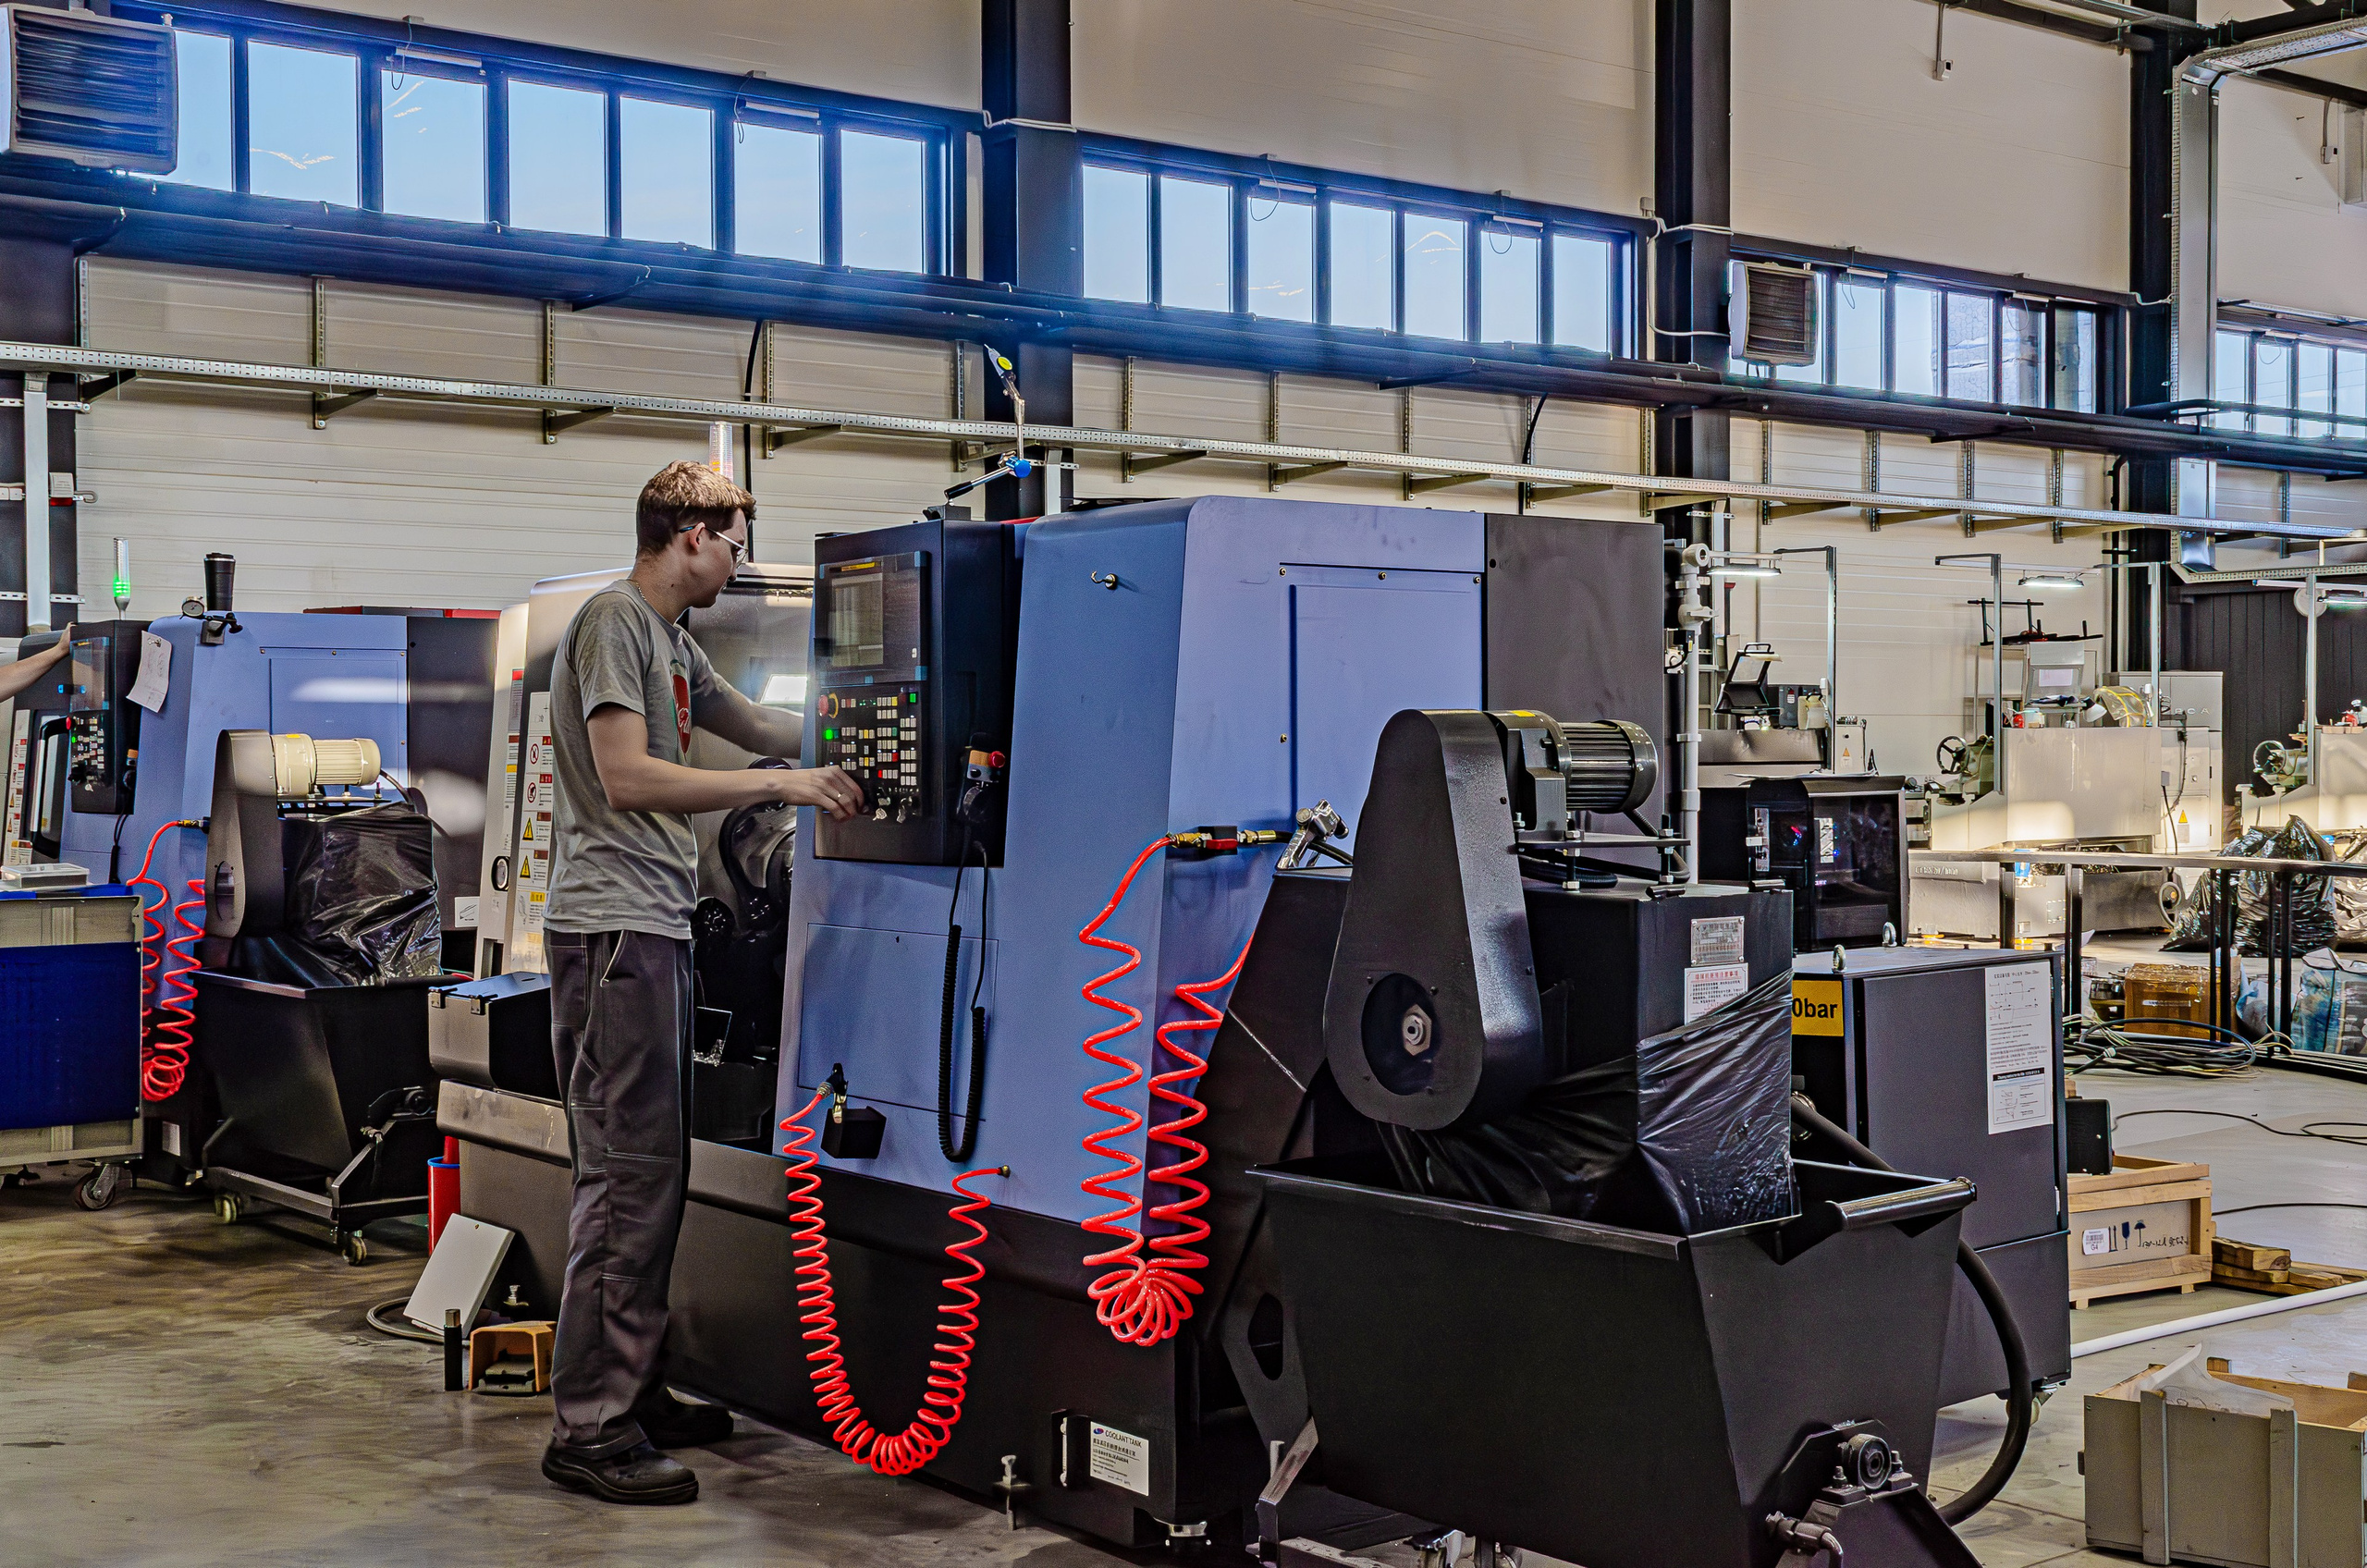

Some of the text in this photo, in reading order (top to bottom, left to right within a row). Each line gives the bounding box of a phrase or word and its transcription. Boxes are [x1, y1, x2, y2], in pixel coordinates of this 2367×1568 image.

[1792, 998, 1838, 1018] 0bar
[1105, 1429, 1128, 1443] COOLANT
[1128, 1437, 1143, 1448] TANK
